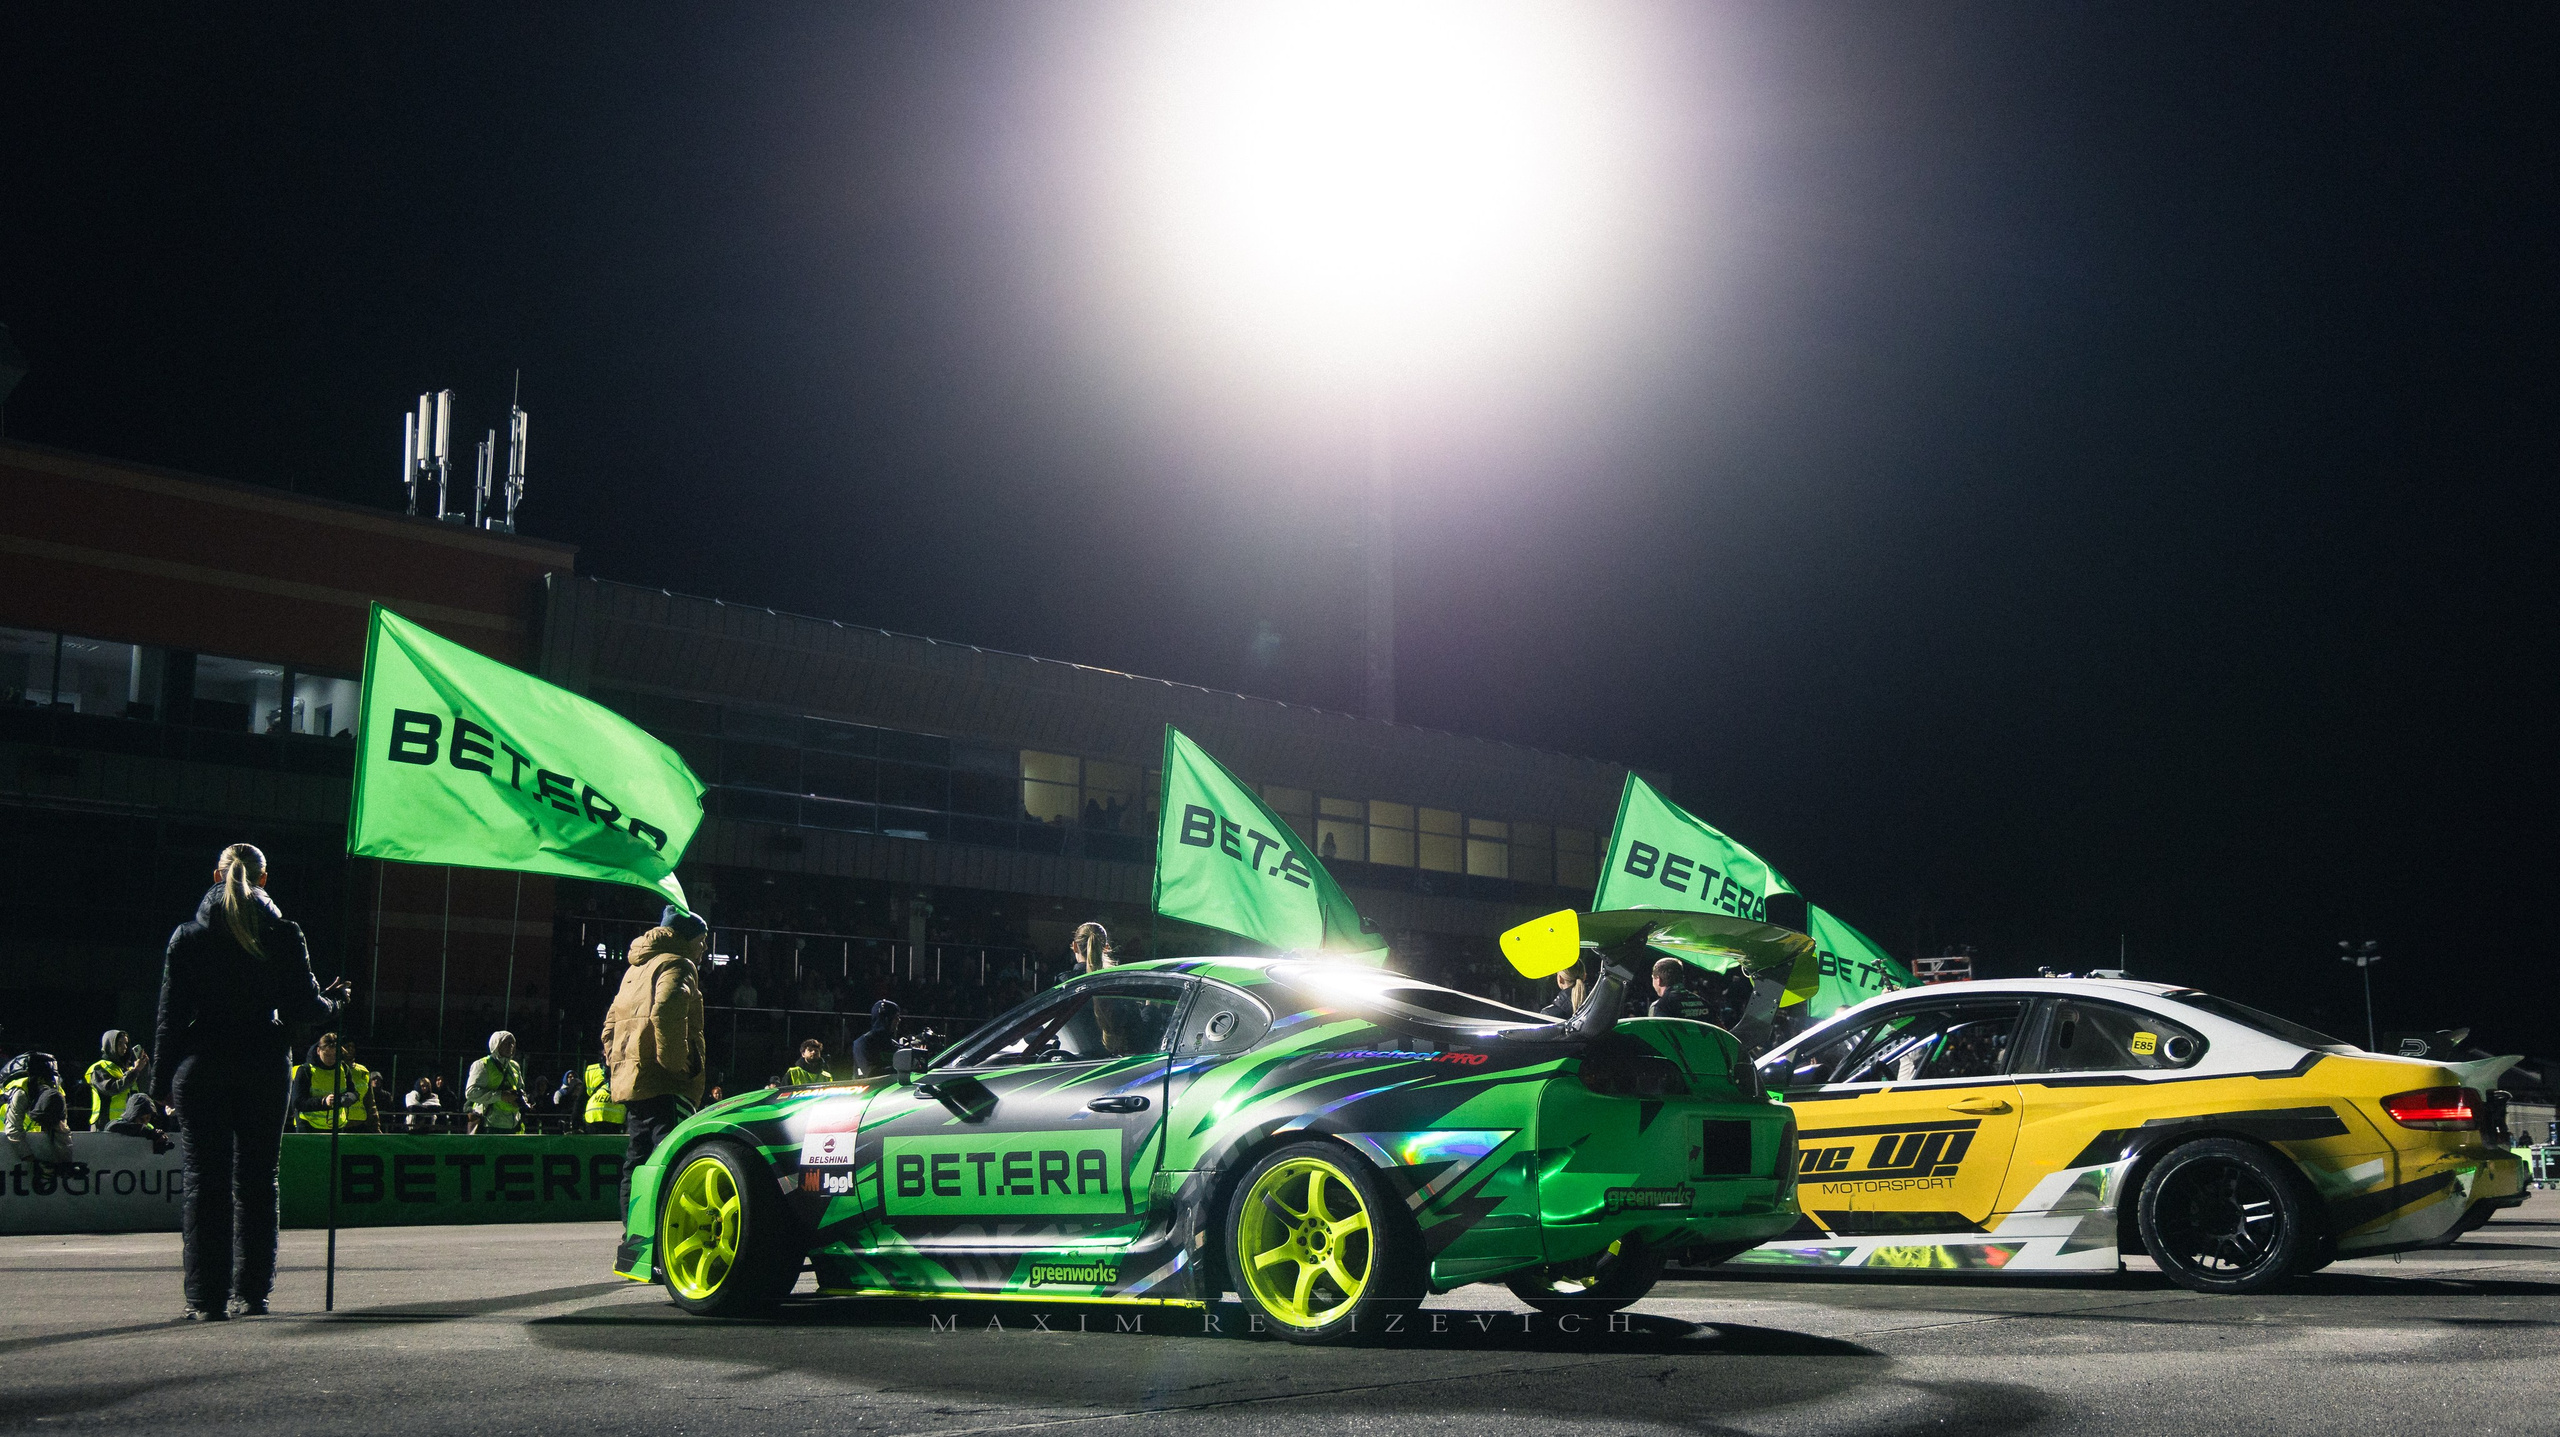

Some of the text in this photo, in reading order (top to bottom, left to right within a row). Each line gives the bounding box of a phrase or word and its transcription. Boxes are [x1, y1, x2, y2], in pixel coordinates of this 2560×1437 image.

[2134, 1040, 2153, 1051] E85
[809, 1155, 848, 1164] BELSHINA
[340, 1153, 624, 1204] BET.ERA
[896, 1149, 1109, 1197] BET.ERA
[1822, 1177, 1956, 1195] MOTORSPORT
[1607, 1185, 1692, 1213] greenworks
[1032, 1262, 1117, 1285] greenworks
